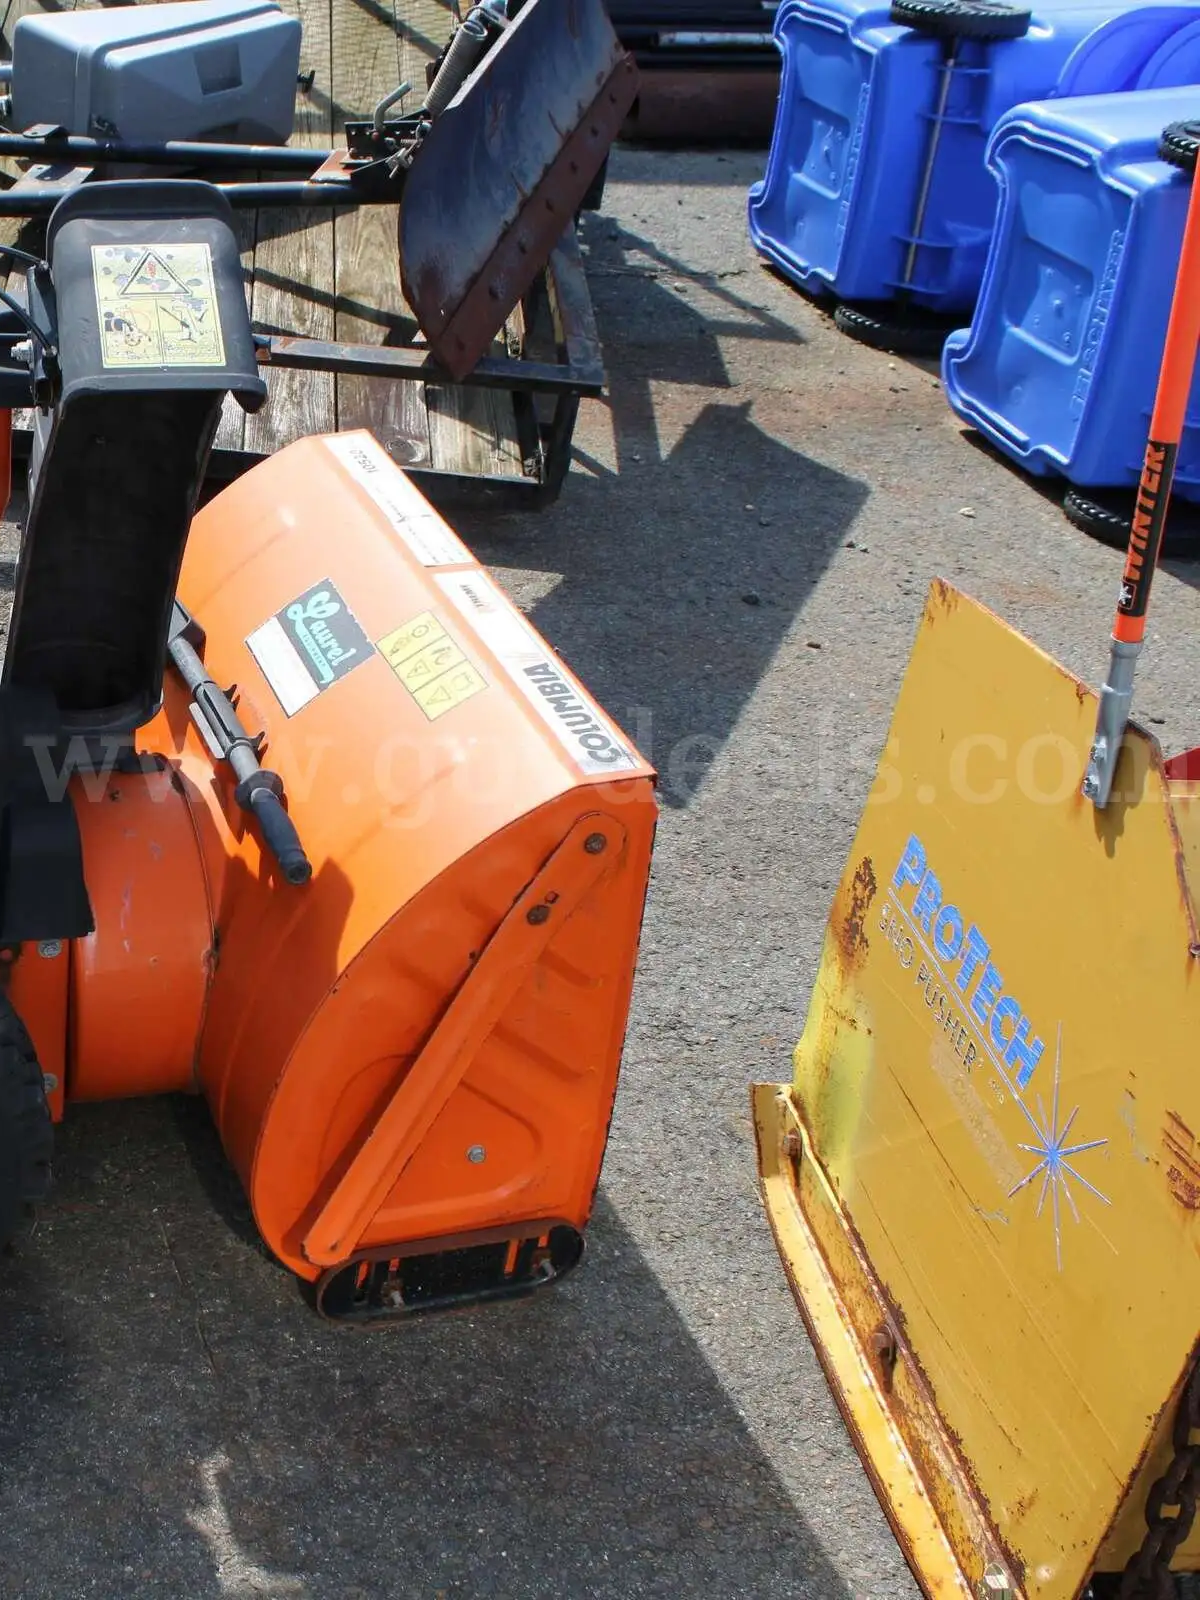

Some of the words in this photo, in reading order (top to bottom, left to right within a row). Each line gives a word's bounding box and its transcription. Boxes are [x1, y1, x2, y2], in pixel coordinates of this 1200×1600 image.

[1123, 442, 1166, 581] WINTER
[287, 591, 356, 667] Laurel
[523, 662, 622, 763] COLUMBIA
[879, 902, 915, 969] SNO
[915, 960, 978, 1074] PUSHER
